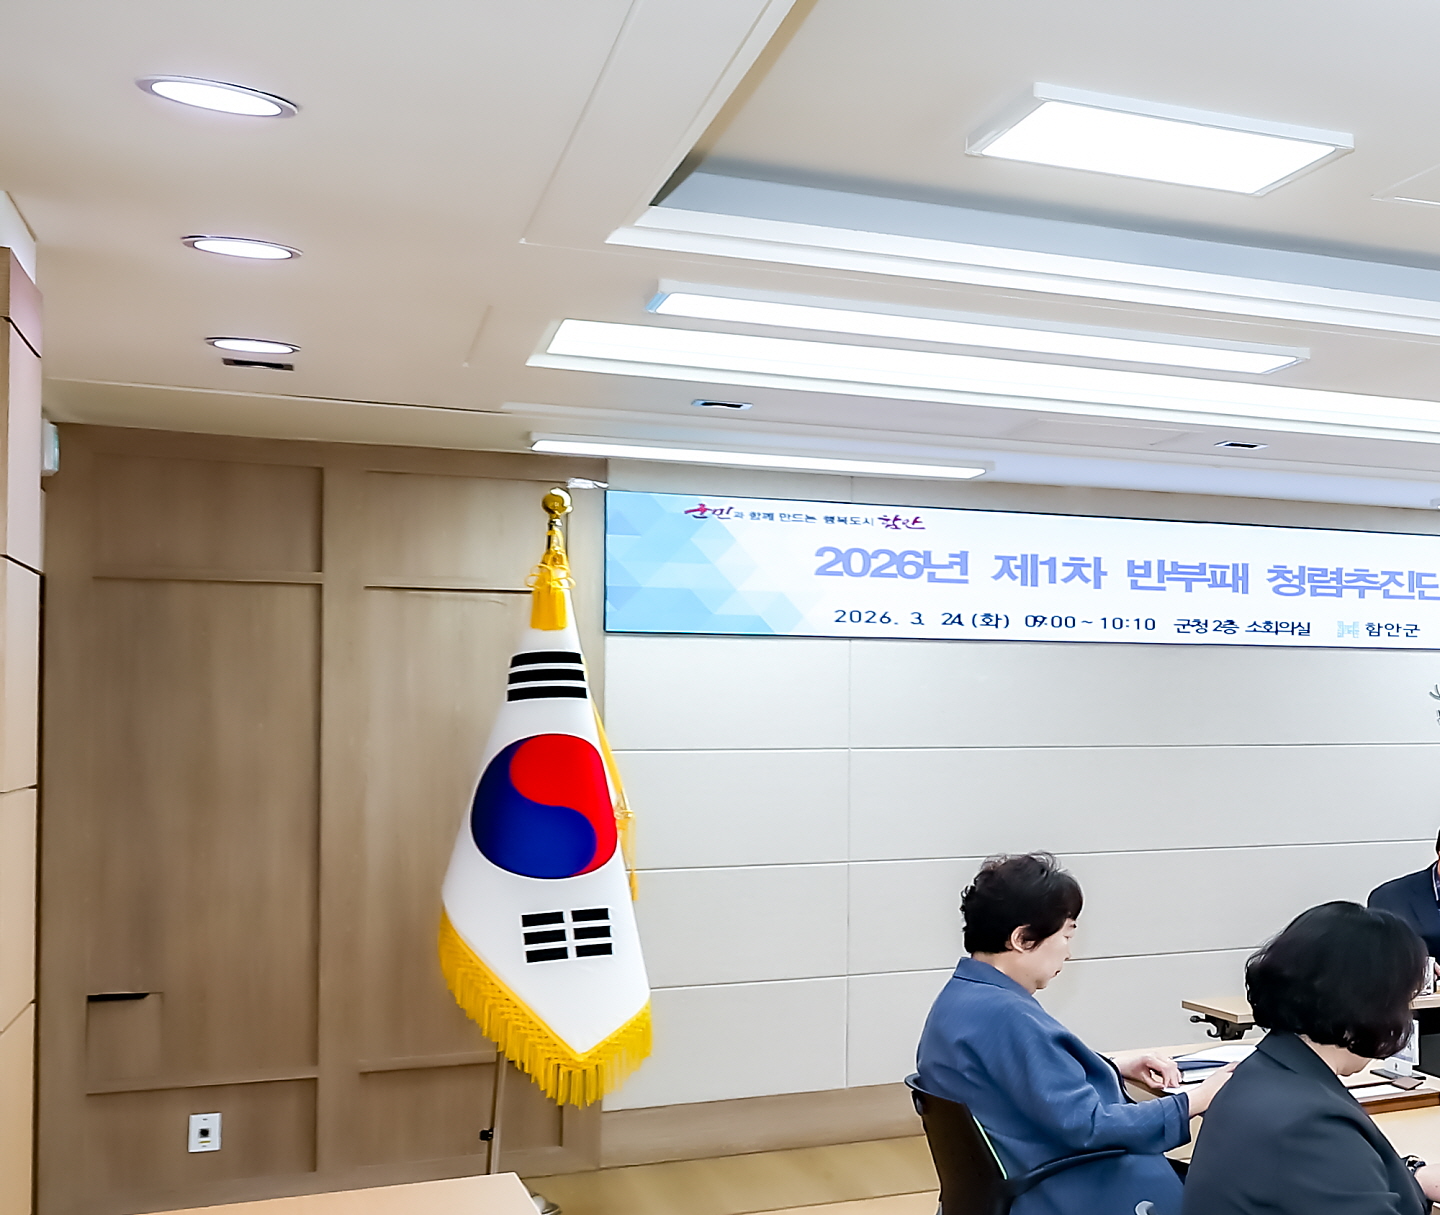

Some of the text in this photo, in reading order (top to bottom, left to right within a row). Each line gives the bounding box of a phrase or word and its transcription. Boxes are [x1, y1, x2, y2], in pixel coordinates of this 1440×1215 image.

[778, 511, 817, 524] 만드는
[814, 546, 970, 585] 2026년
[991, 553, 1108, 590] 제1차
[1126, 559, 1250, 595] 반부패
[834, 609, 899, 625] 2026.
[972, 612, 1010, 629] (화)
[1025, 614, 1076, 629] 09:00
[1100, 617, 1156, 631] 10:10
[1173, 618, 1208, 634] 군청
[1212, 619, 1240, 635] 2층
[1245, 620, 1311, 637] 소회의실
[1365, 622, 1421, 638] 함안군
